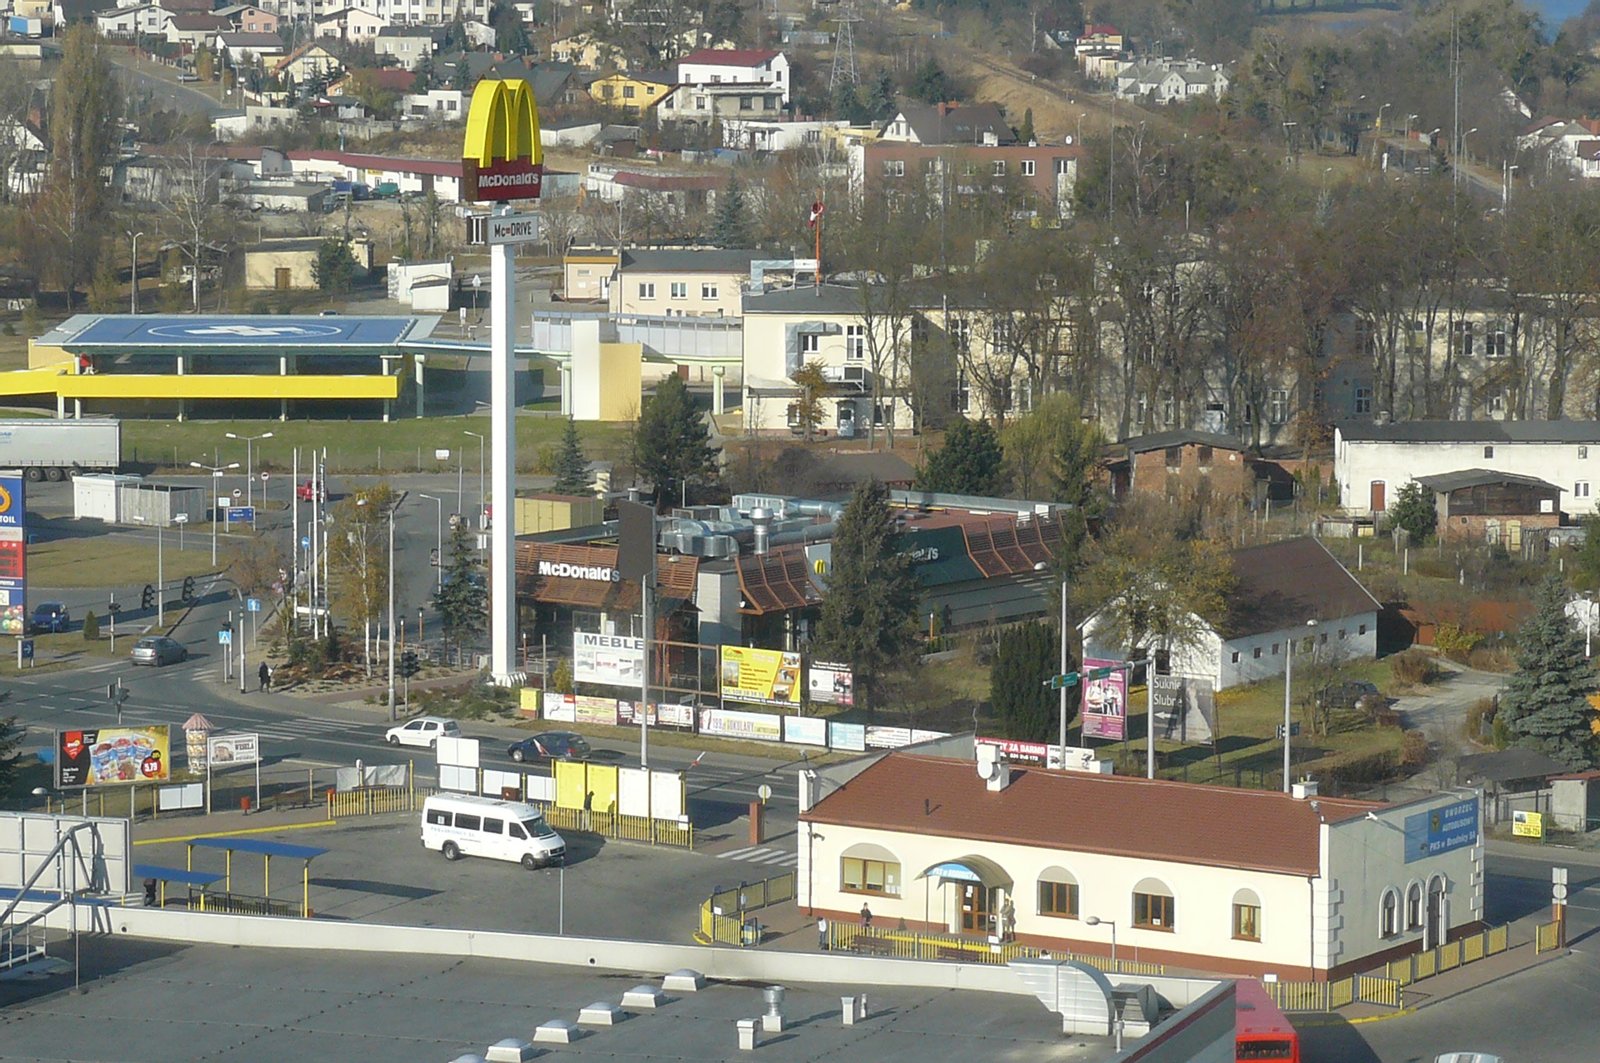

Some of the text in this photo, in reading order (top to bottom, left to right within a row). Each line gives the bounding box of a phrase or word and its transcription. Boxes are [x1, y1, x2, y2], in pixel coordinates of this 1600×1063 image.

[478, 172, 539, 187] McDonald's
[584, 635, 644, 650] MEBLE
[1020, 744, 1046, 755] DARMO
